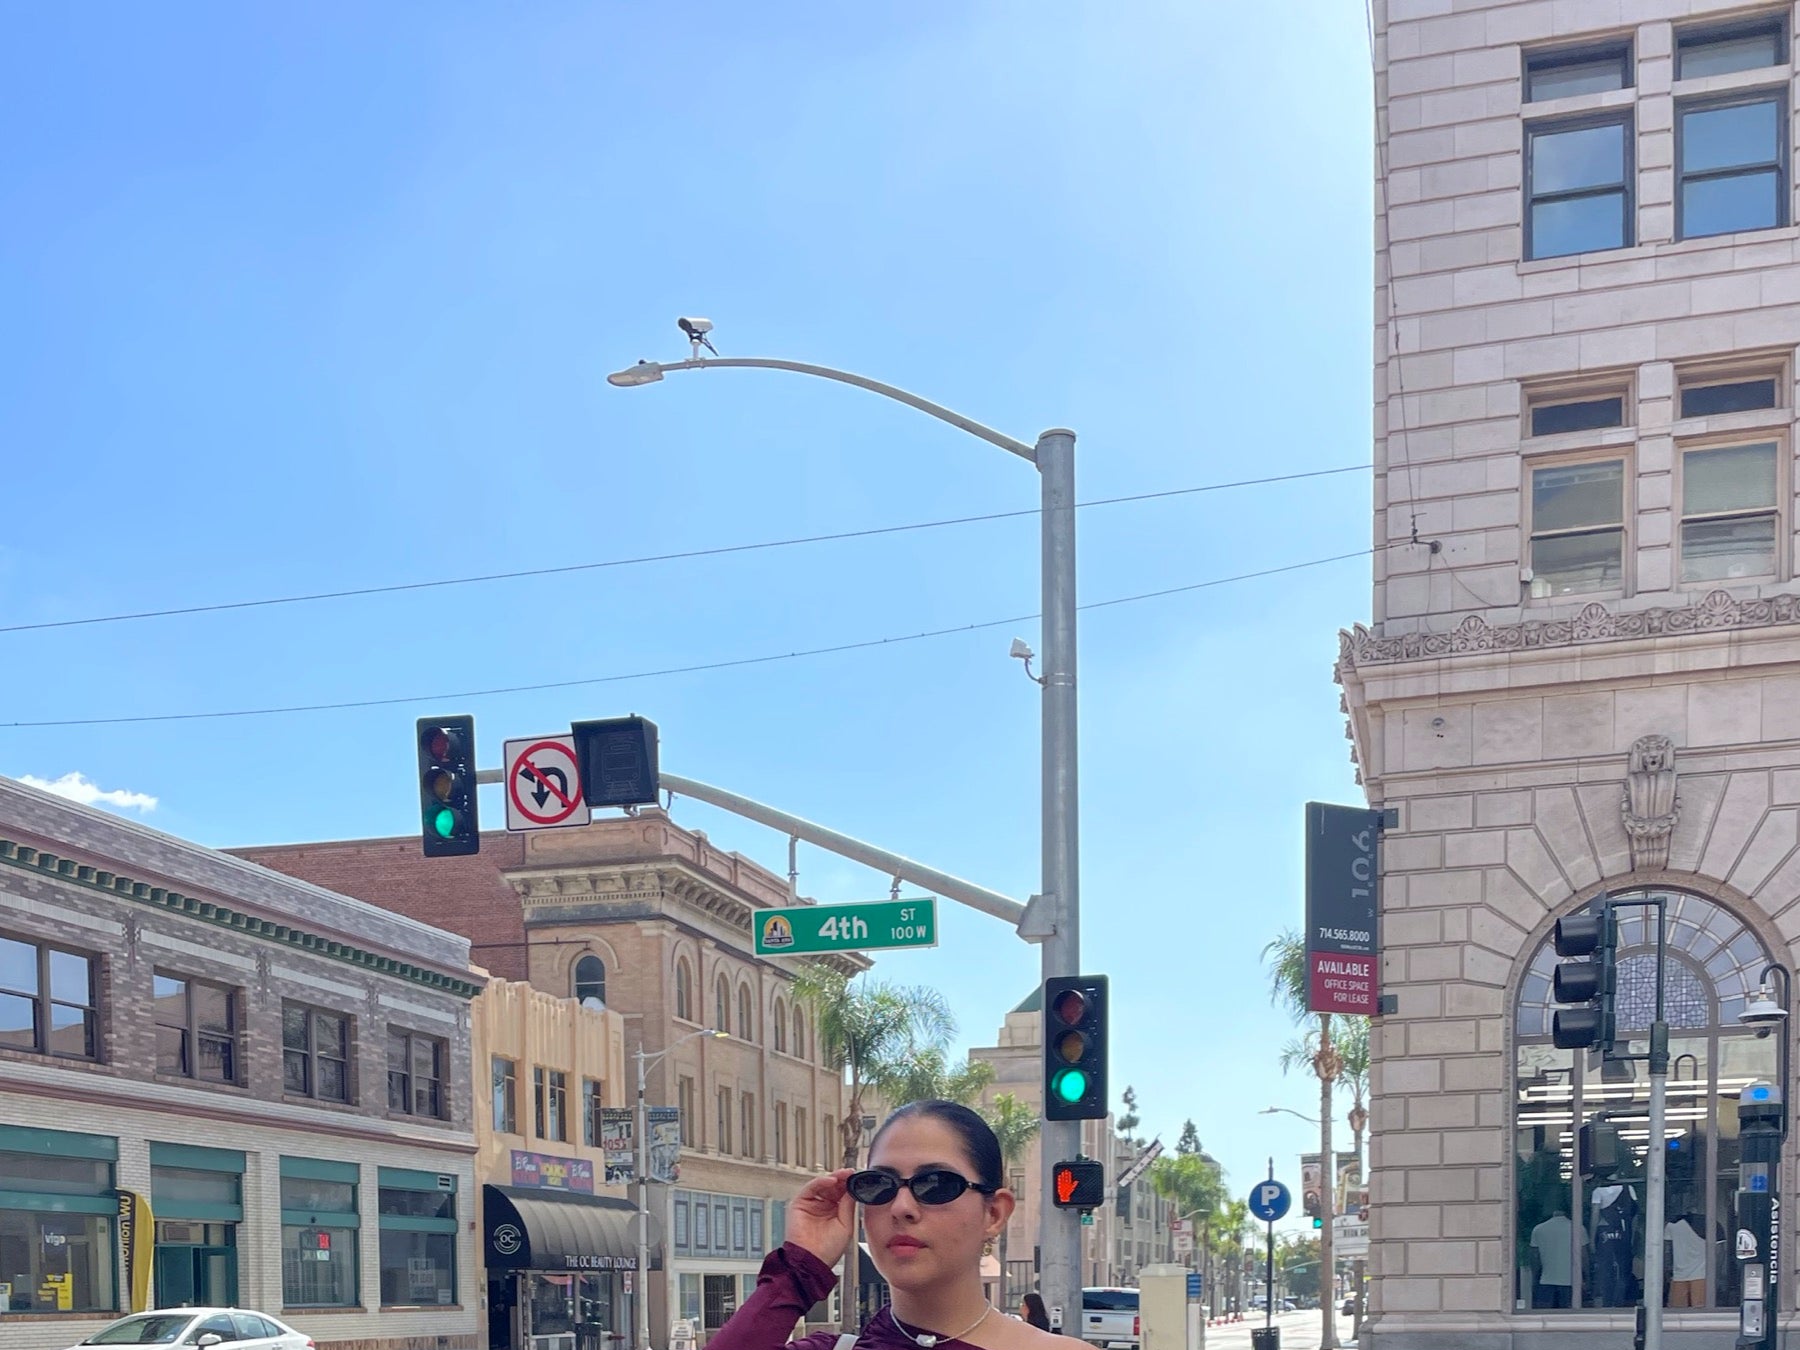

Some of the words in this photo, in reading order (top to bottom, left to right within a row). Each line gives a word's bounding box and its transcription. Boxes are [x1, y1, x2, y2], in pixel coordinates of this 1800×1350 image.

[900, 908, 916, 922] ST
[818, 915, 868, 941] 4th
[891, 926, 913, 940] 100
[916, 925, 927, 938] W
[1319, 927, 1370, 942] 714.565.8000
[1317, 960, 1370, 977] AVAILABLE
[1324, 979, 1347, 990] OFFICE
[1348, 980, 1369, 992] SPACE
[1333, 992, 1347, 1003] FOR
[1348, 993, 1369, 1004] LEASE
[1261, 1186, 1281, 1206] P
[45, 1232, 66, 1246] vigo
[500, 1234, 516, 1243] OC
[1769, 1197, 1780, 1284] Asistencia
[565, 1255, 578, 1267] THE
[579, 1255, 590, 1267] OC
[591, 1255, 612, 1268] BEAUTY
[613, 1256, 636, 1269] LOUNGE
